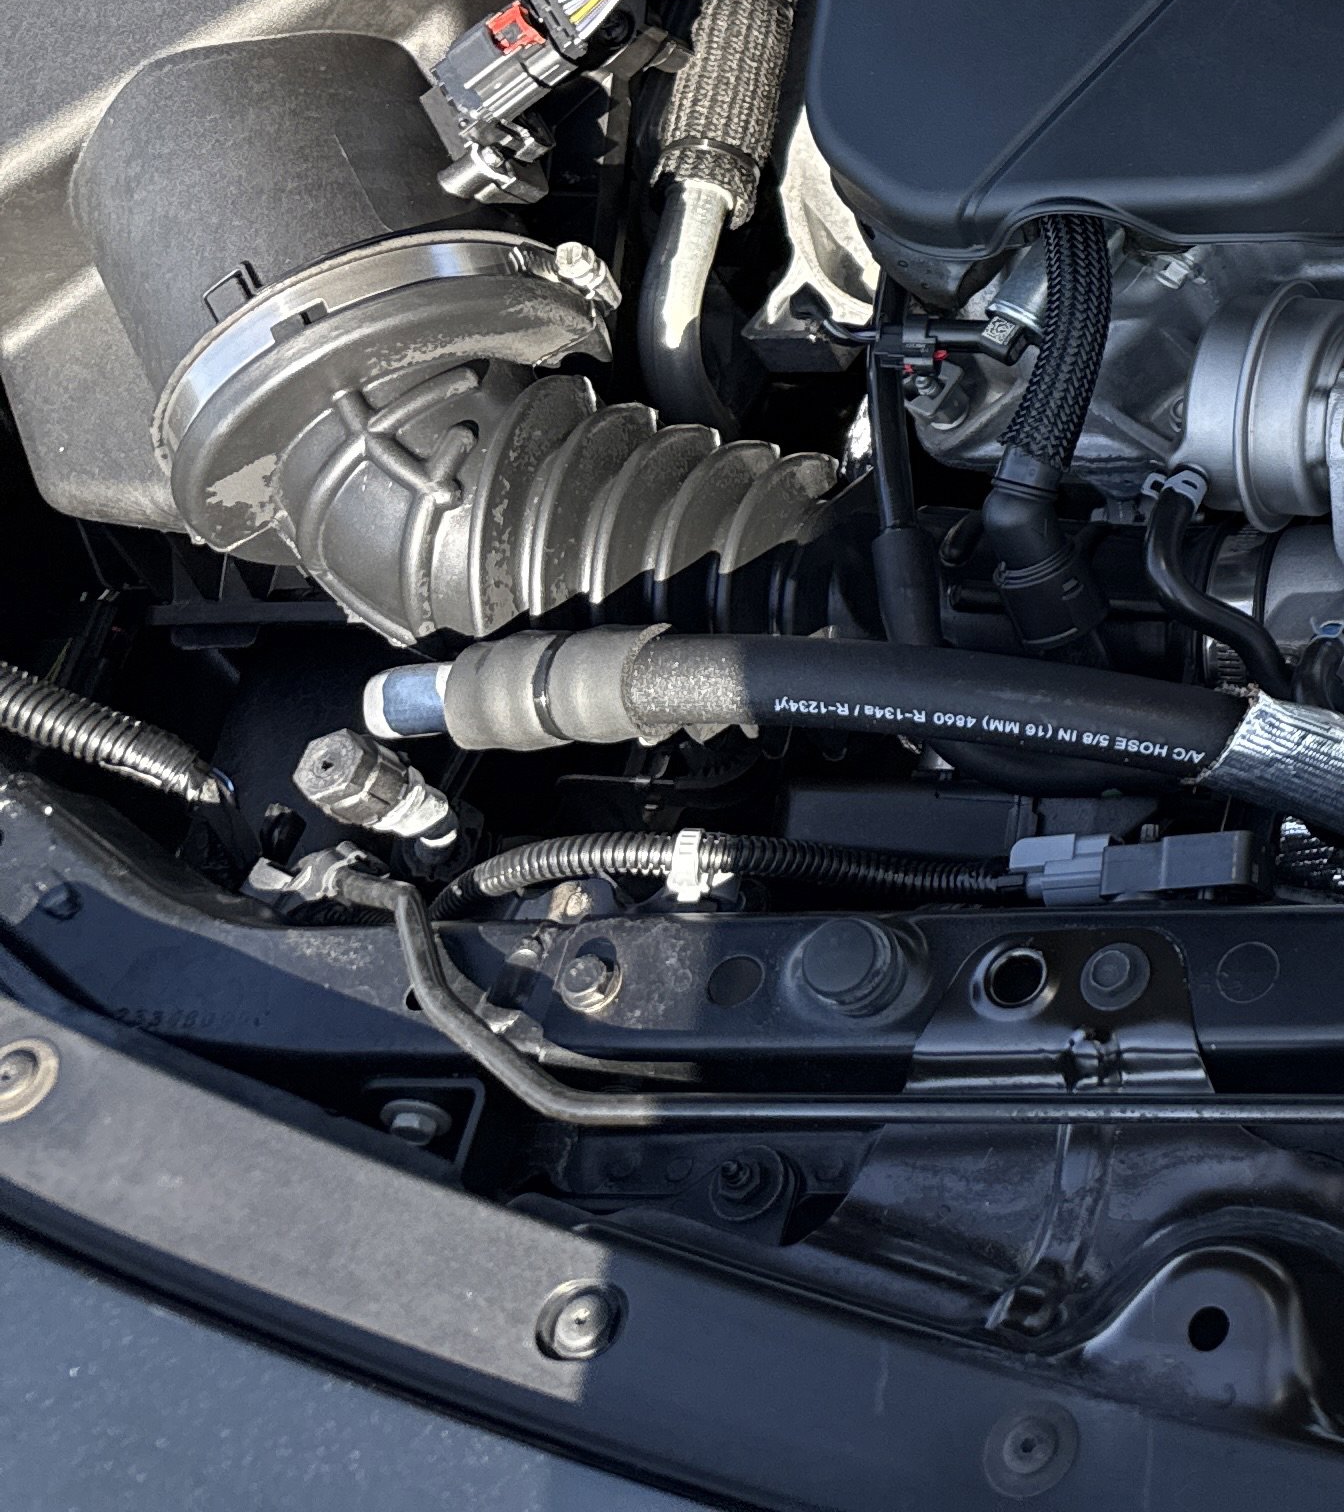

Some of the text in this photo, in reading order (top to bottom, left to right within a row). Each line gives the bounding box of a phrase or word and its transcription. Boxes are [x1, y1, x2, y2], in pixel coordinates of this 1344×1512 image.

[774, 696, 1205, 763] A/C HOSE 5/8 IN (16 MM) 4860 R-134a / R-1234yf
